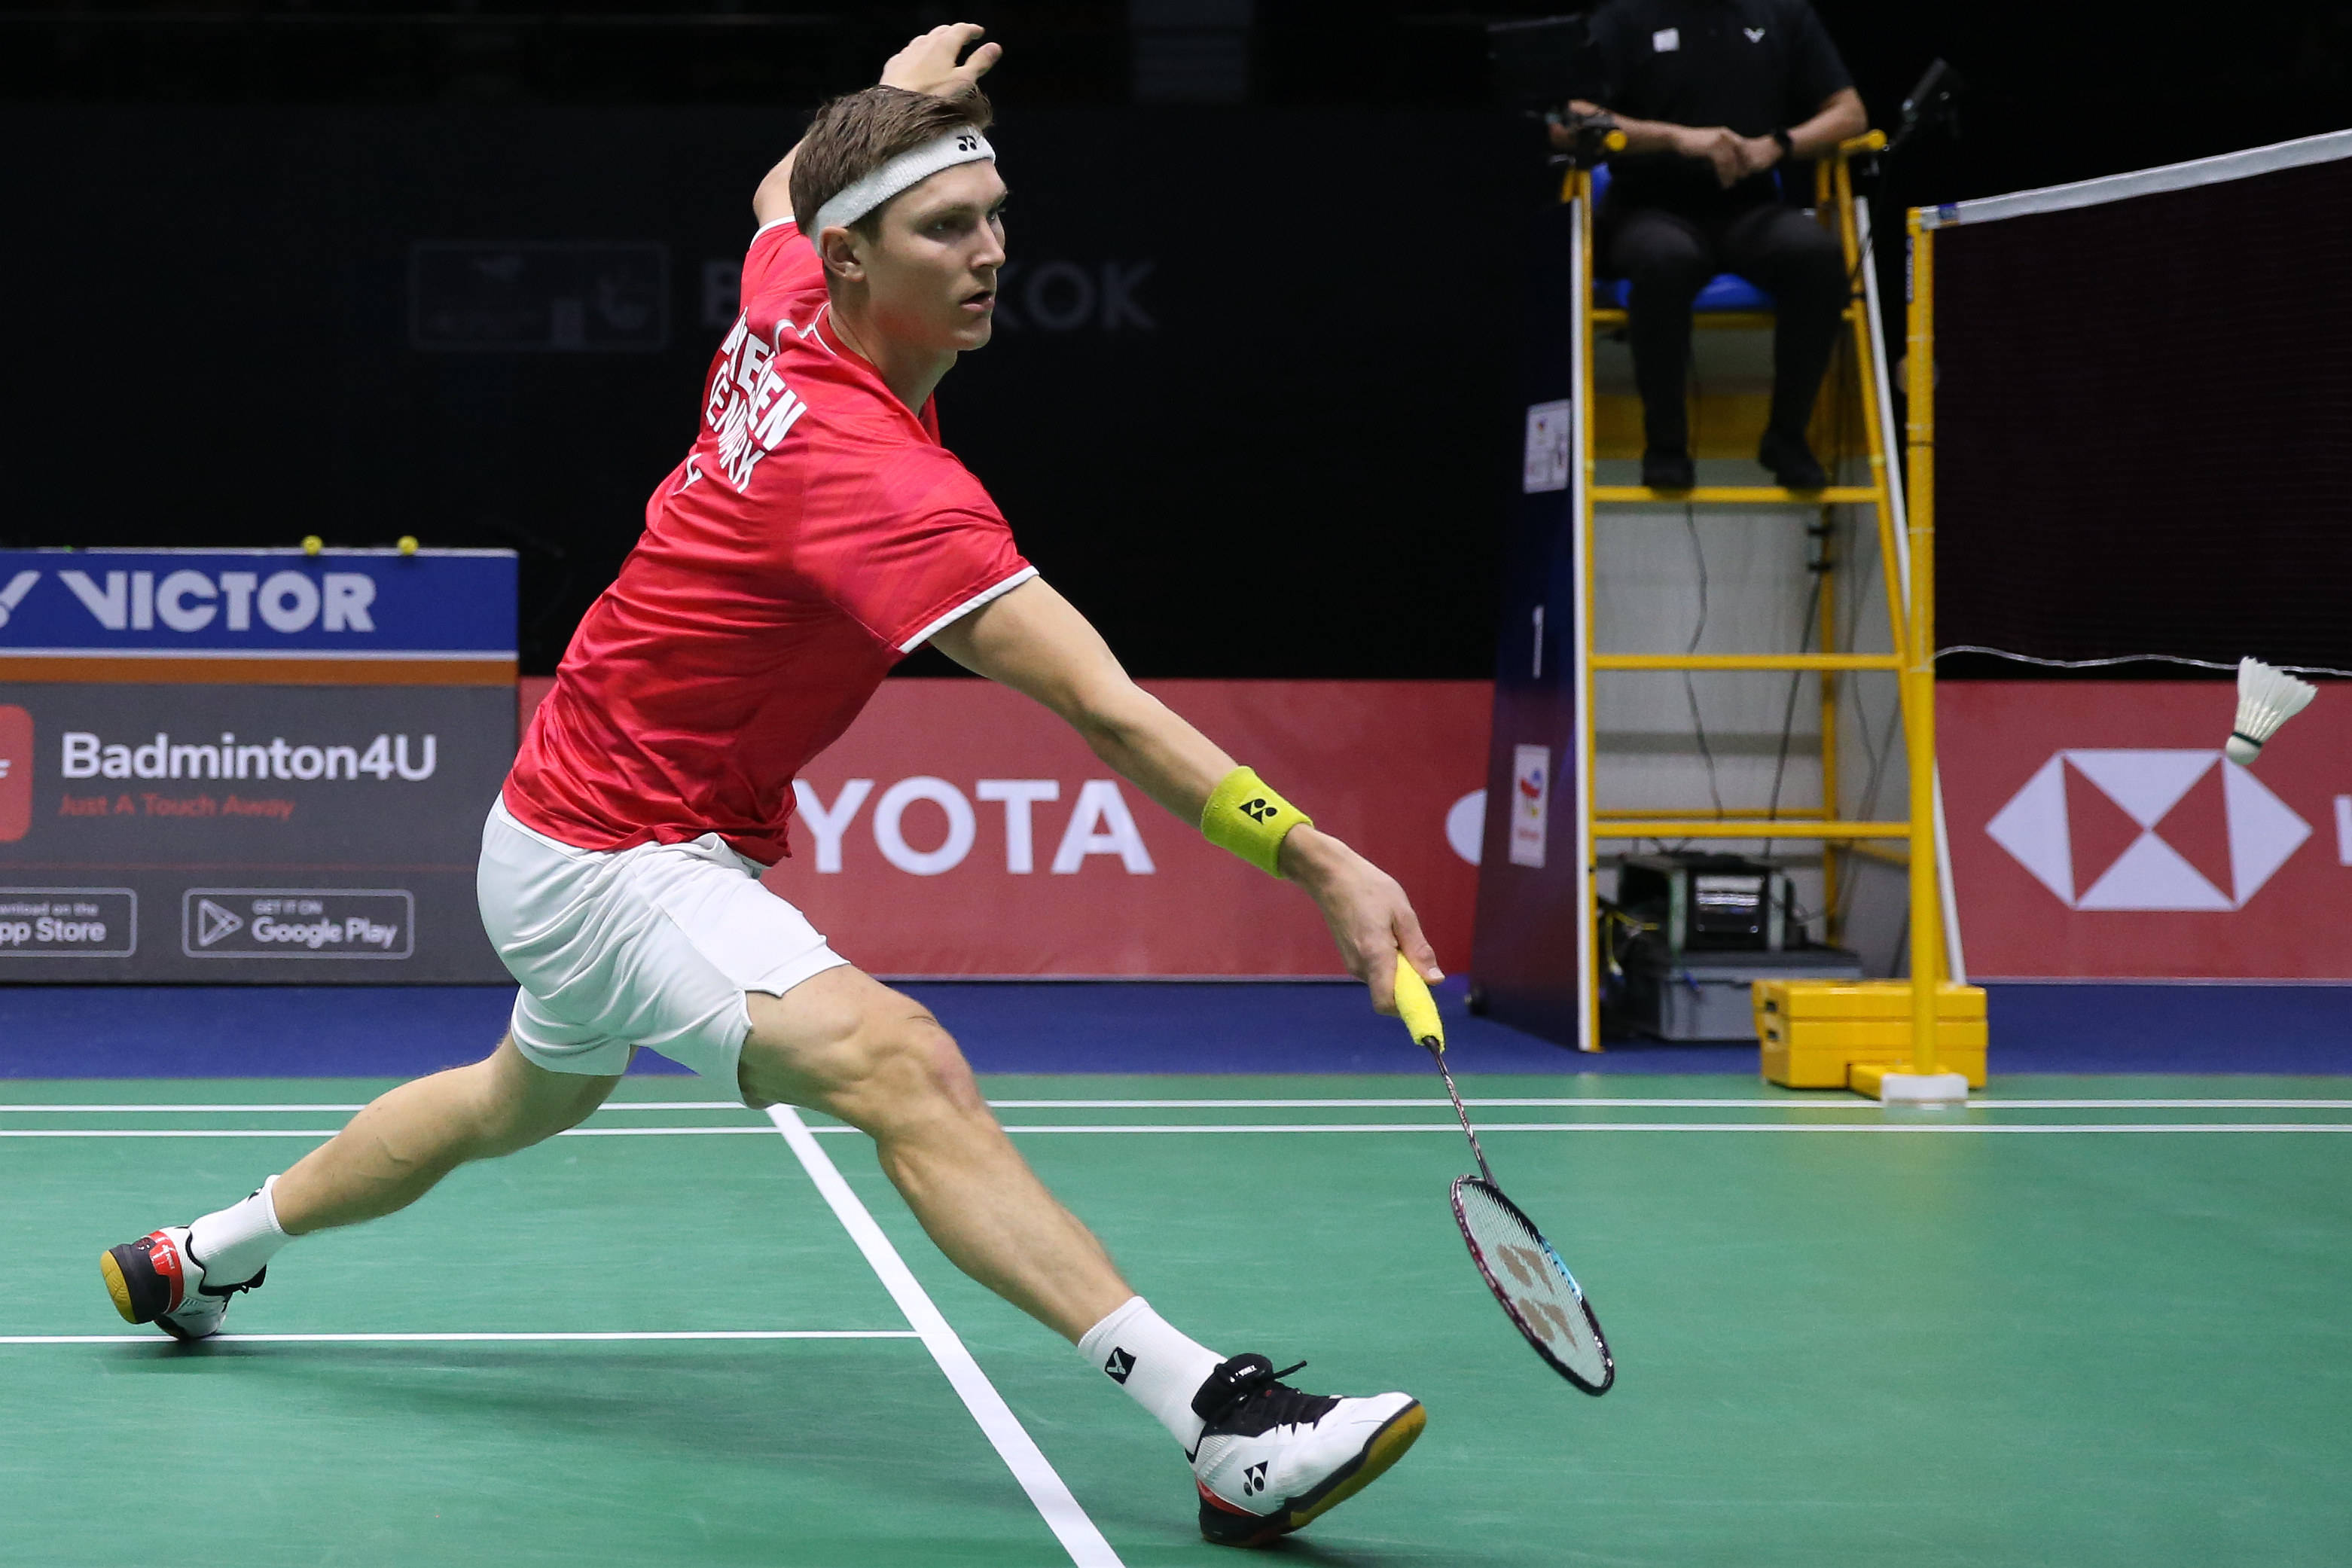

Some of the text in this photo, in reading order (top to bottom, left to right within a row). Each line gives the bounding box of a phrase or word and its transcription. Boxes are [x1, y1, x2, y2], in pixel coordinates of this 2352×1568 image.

[59, 569, 377, 633] VICTOR
[60, 731, 437, 780] Badminton4U
[59, 792, 295, 822] Just A Touch Away
[793, 776, 1156, 875] YOTA
[0, 917, 107, 947] pp Store
[252, 916, 398, 949] Google Play
